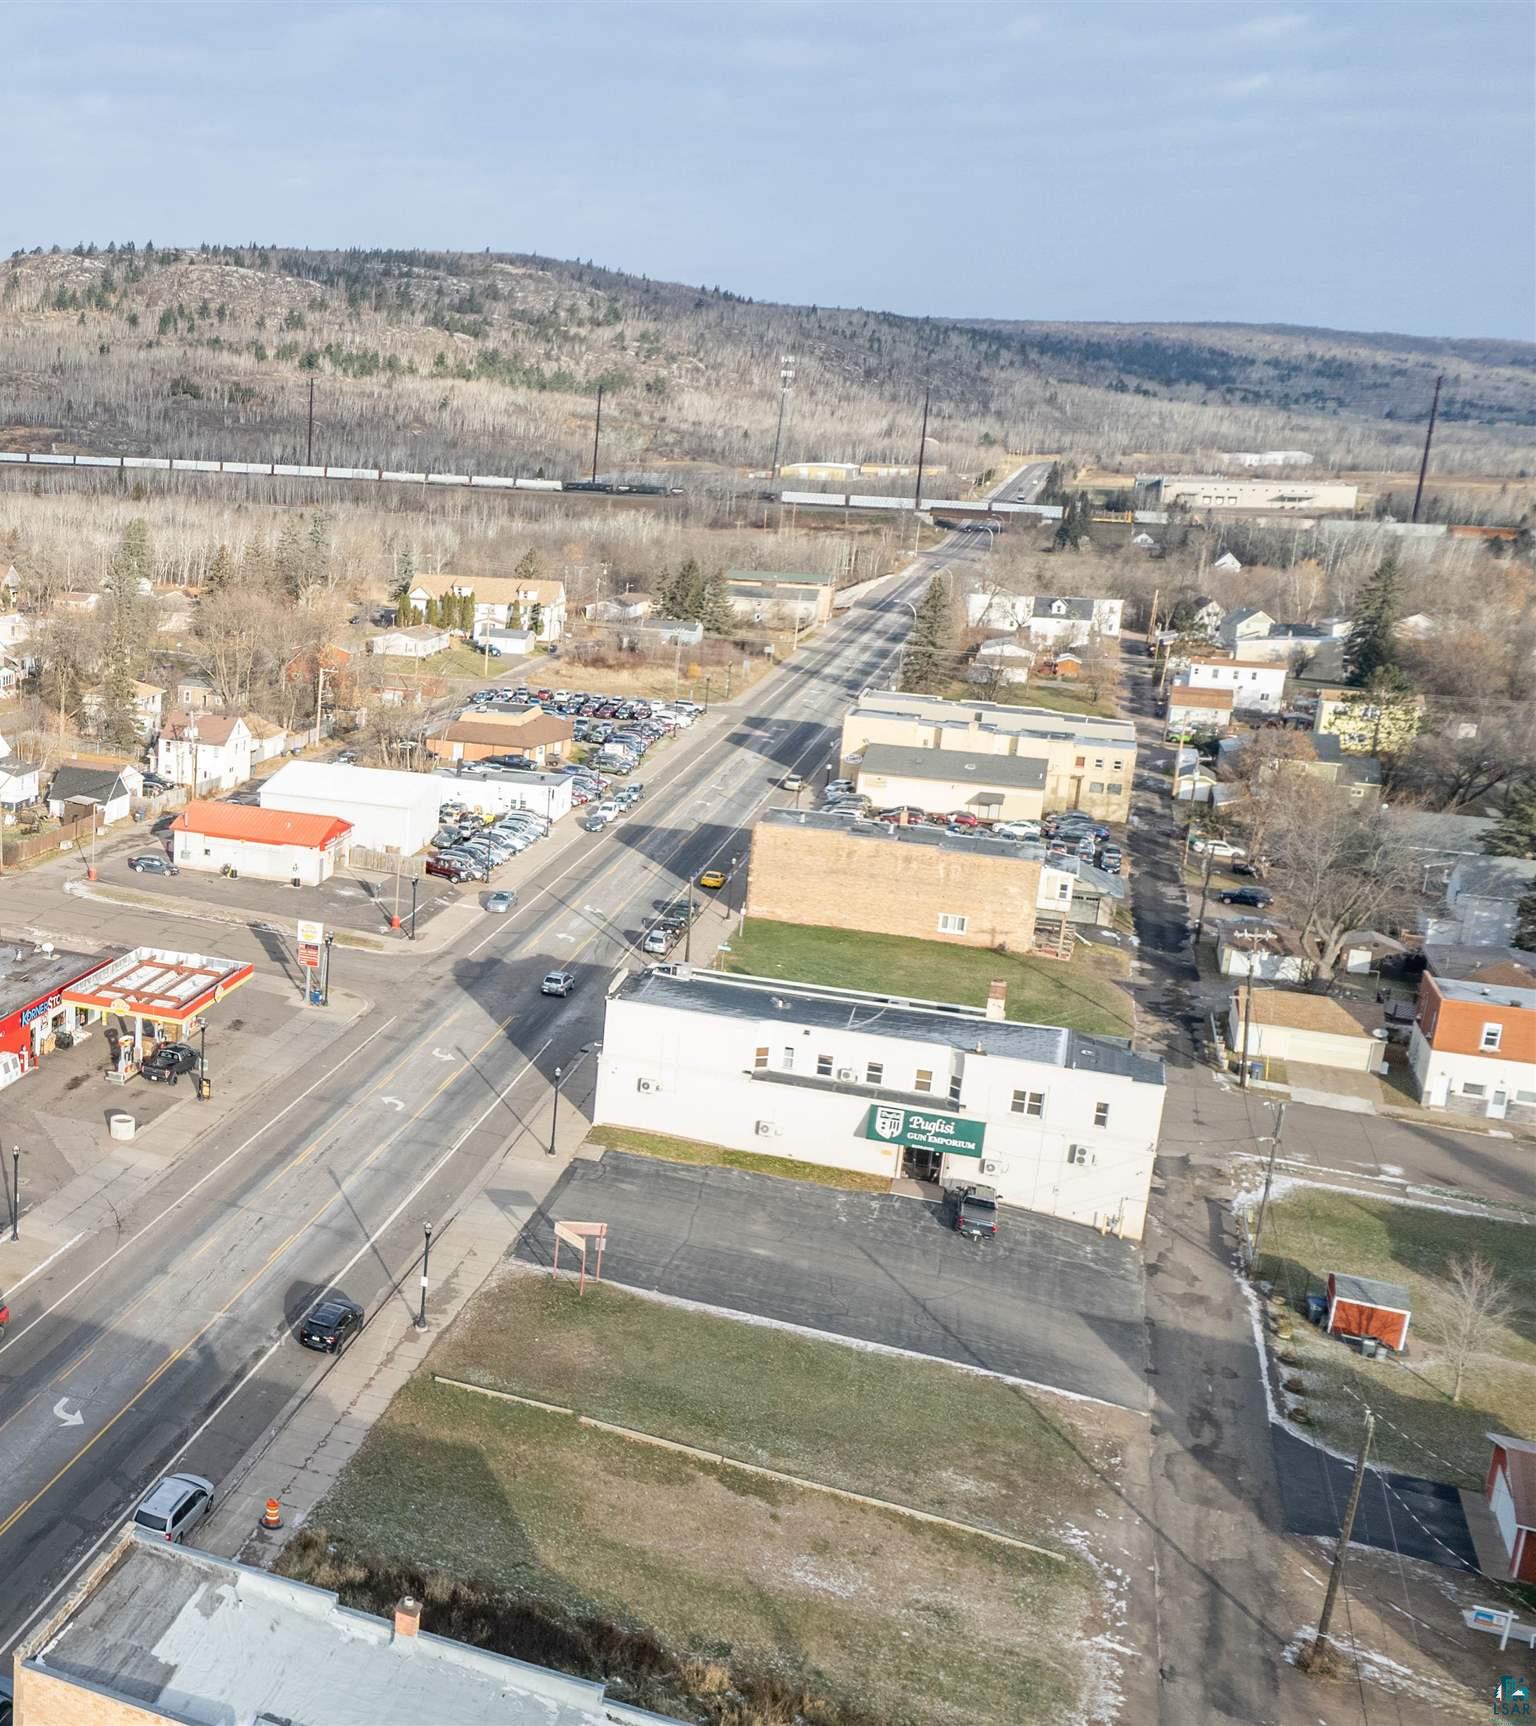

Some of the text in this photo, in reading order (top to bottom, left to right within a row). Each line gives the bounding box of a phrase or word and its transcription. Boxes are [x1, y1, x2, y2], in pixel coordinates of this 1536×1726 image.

[909, 1116, 955, 1135] Puglisi
[907, 1132, 927, 1142] GUN
[928, 1135, 976, 1150] EMPORIUM
